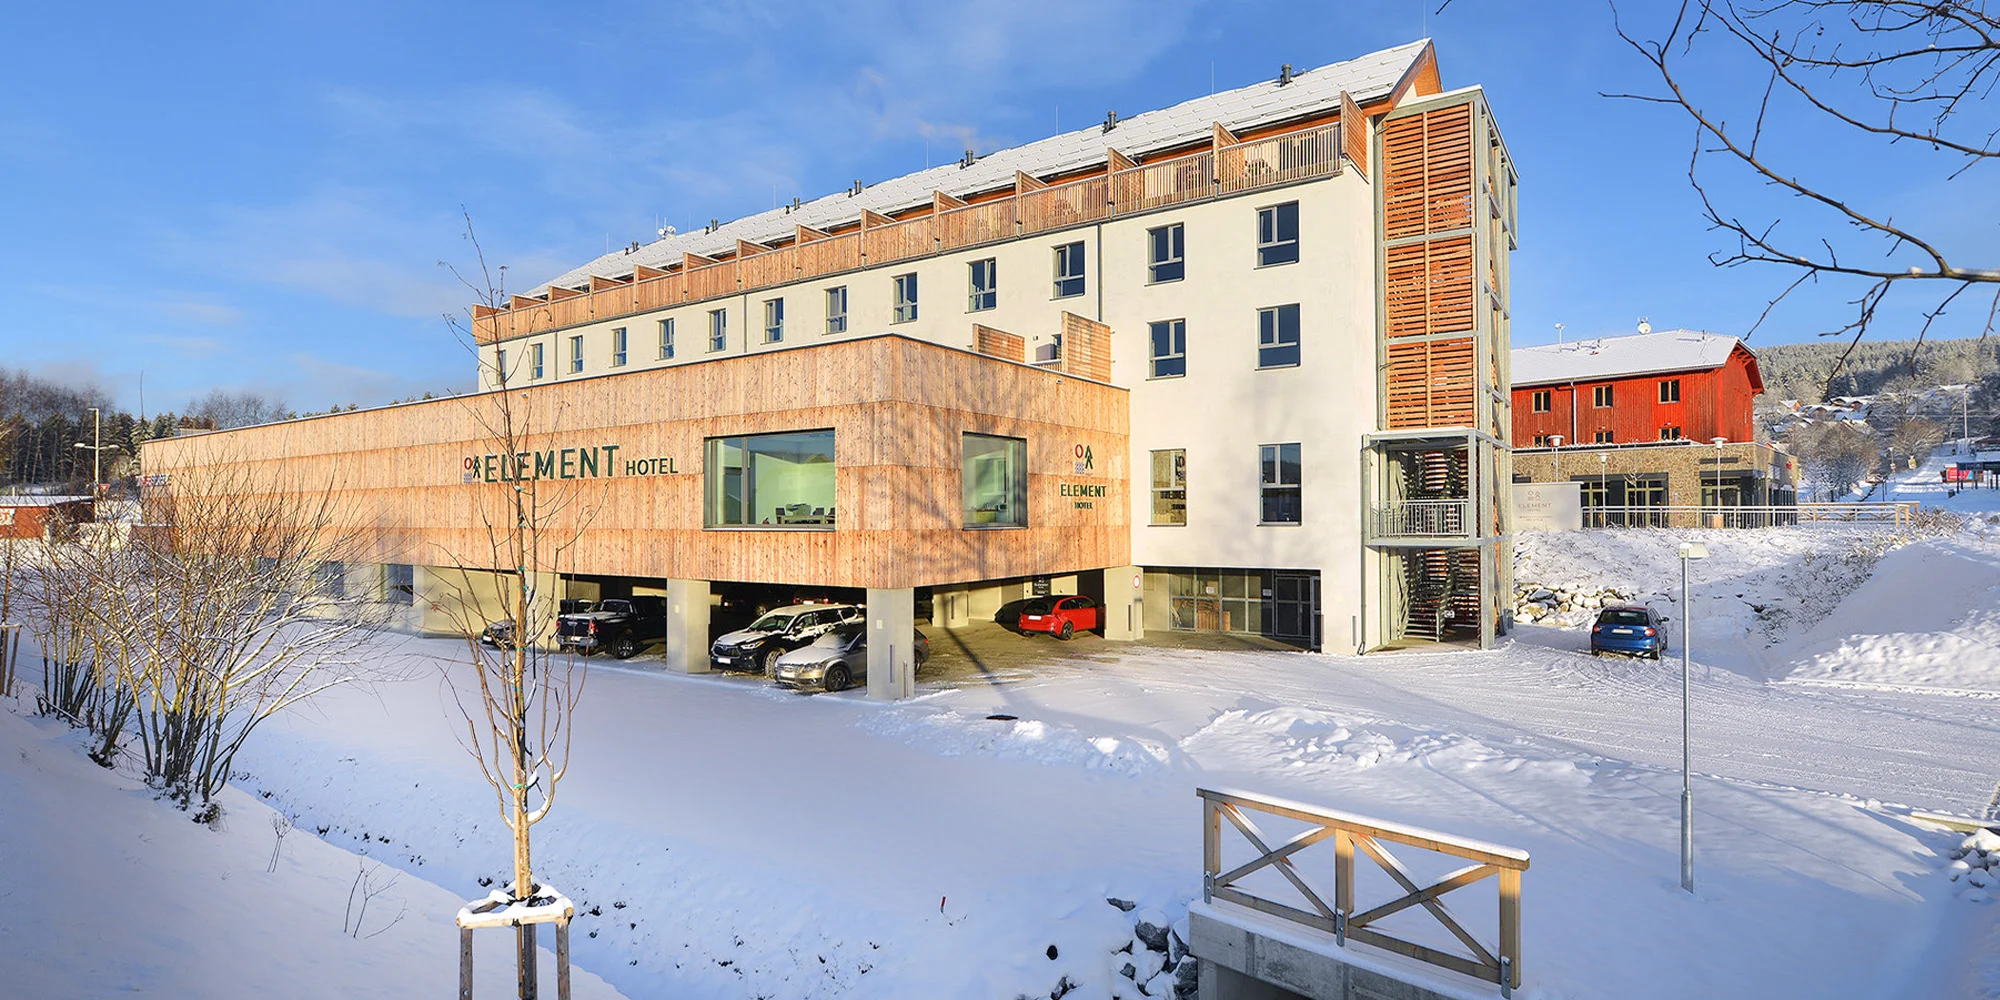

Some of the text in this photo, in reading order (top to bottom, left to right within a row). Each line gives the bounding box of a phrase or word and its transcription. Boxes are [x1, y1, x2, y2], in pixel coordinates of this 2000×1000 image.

[484, 445, 679, 483] ELEMENT HOTEL
[1060, 483, 1107, 498] ELEMENT
[1074, 501, 1092, 510] HOTEL
